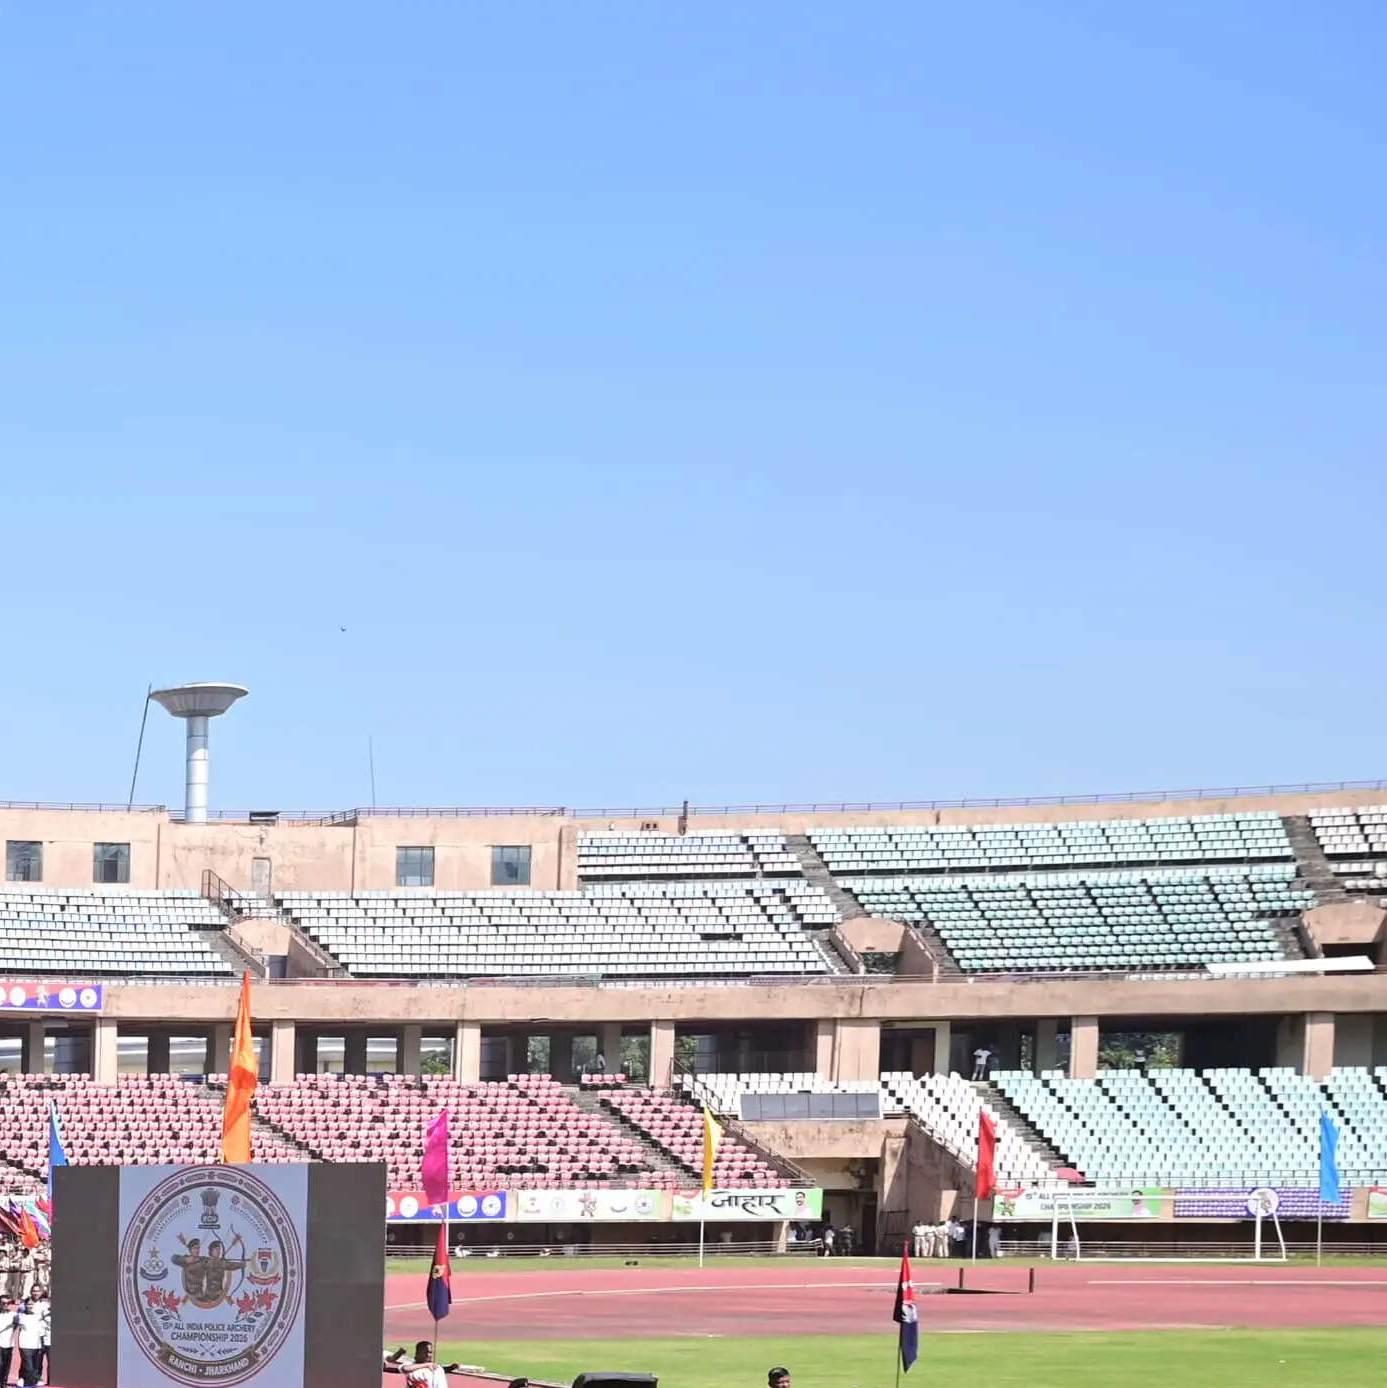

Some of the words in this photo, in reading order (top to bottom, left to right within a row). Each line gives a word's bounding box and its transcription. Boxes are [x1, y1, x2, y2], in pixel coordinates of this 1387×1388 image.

[174, 1323, 184, 1331] ALL
[186, 1323, 204, 1331] INDIA
[204, 1323, 225, 1332] POLICE
[226, 1324, 256, 1333] ARCHERY
[170, 1332, 229, 1343] CHAMPIONSHIP
[168, 1355, 197, 1375] RANCHI
[204, 1357, 250, 1376] JHARKHAND
